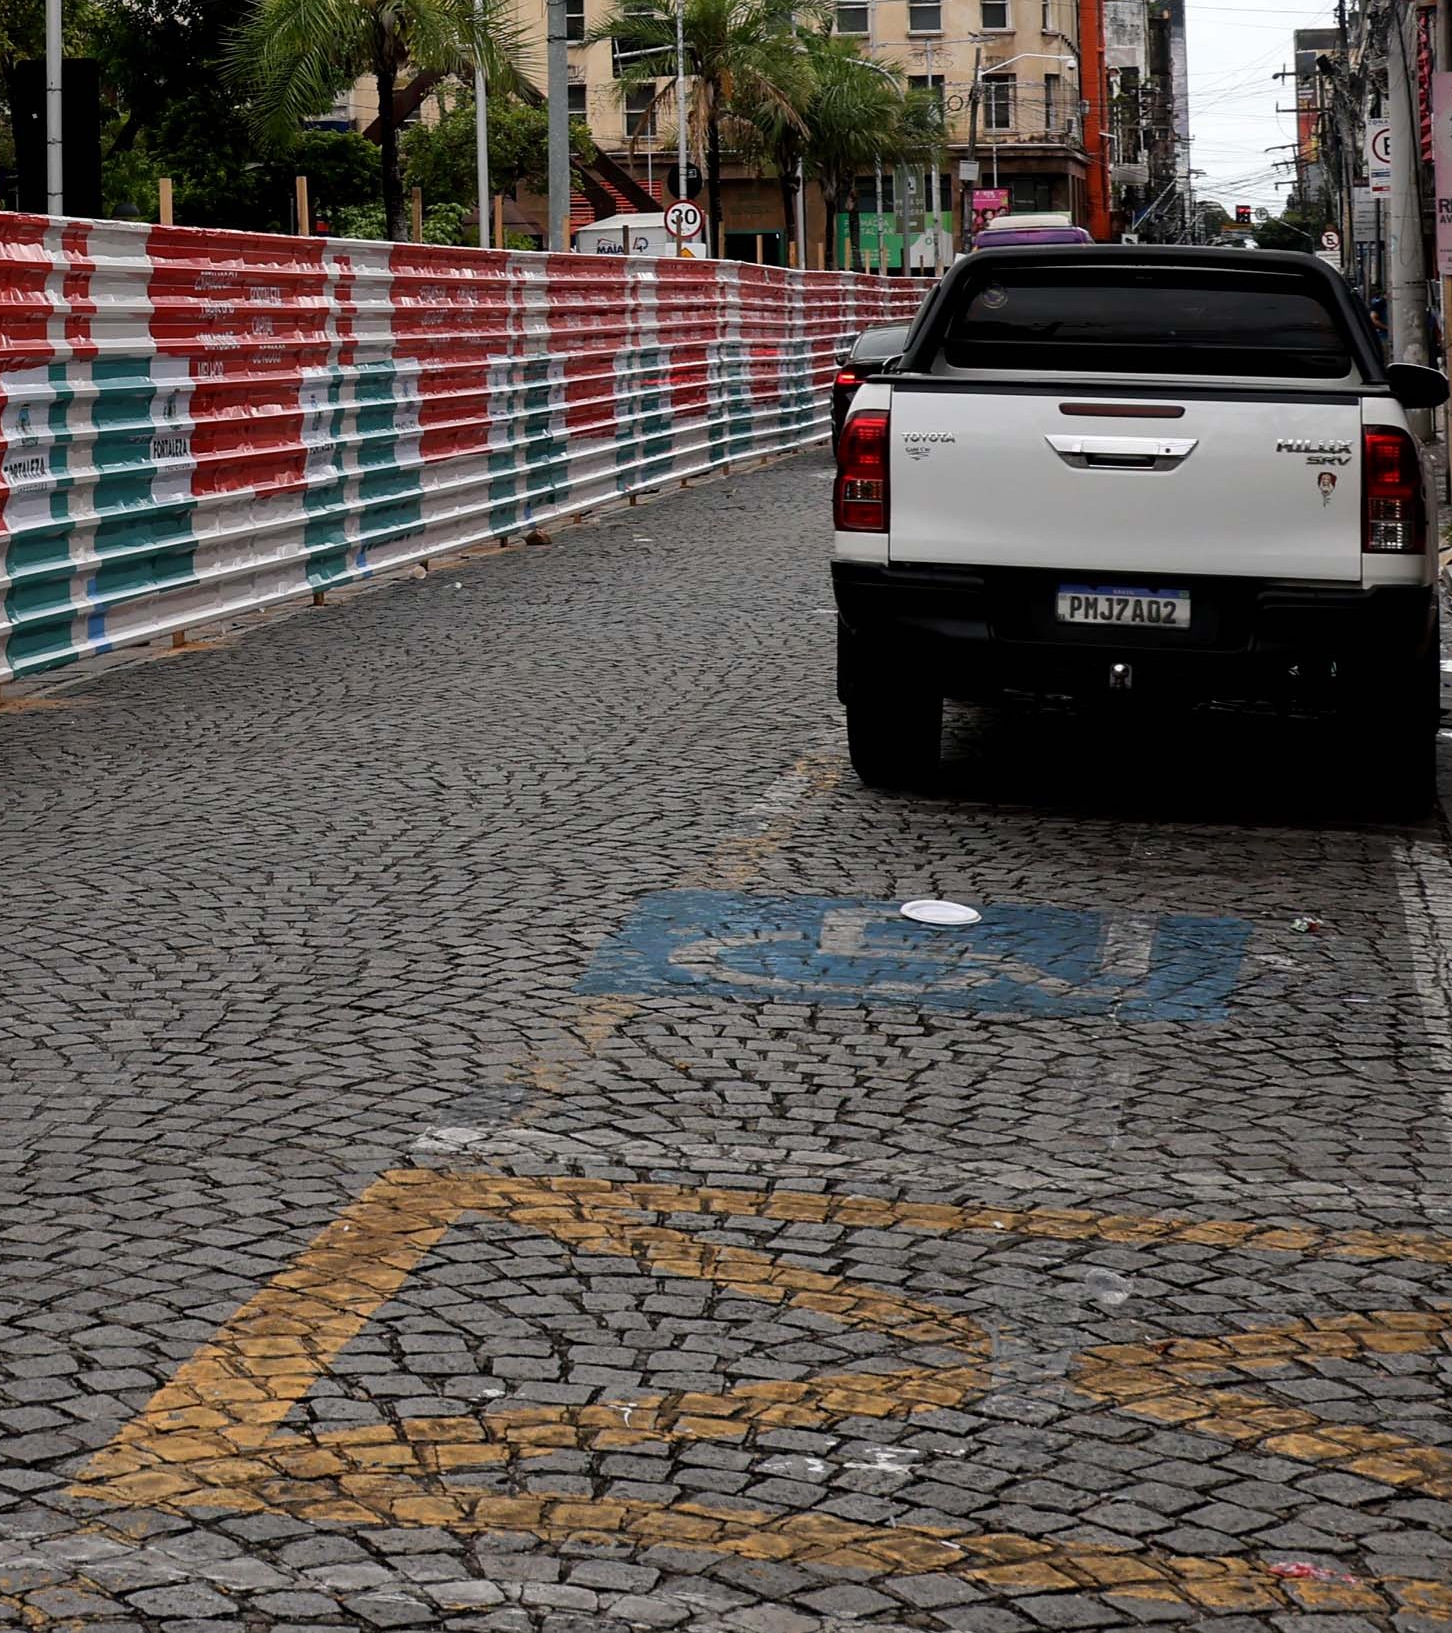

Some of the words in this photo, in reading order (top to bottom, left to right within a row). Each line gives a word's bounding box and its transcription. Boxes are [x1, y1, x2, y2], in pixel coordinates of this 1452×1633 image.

[670, 208, 698, 225] 30
[901, 432, 956, 443] TOYOTA
[153, 438, 188, 459] FORTALEZA
[1276, 438, 1353, 454] HILUX
[1306, 455, 1352, 466] SRV
[1069, 595, 1177, 625] PMJ7A02
